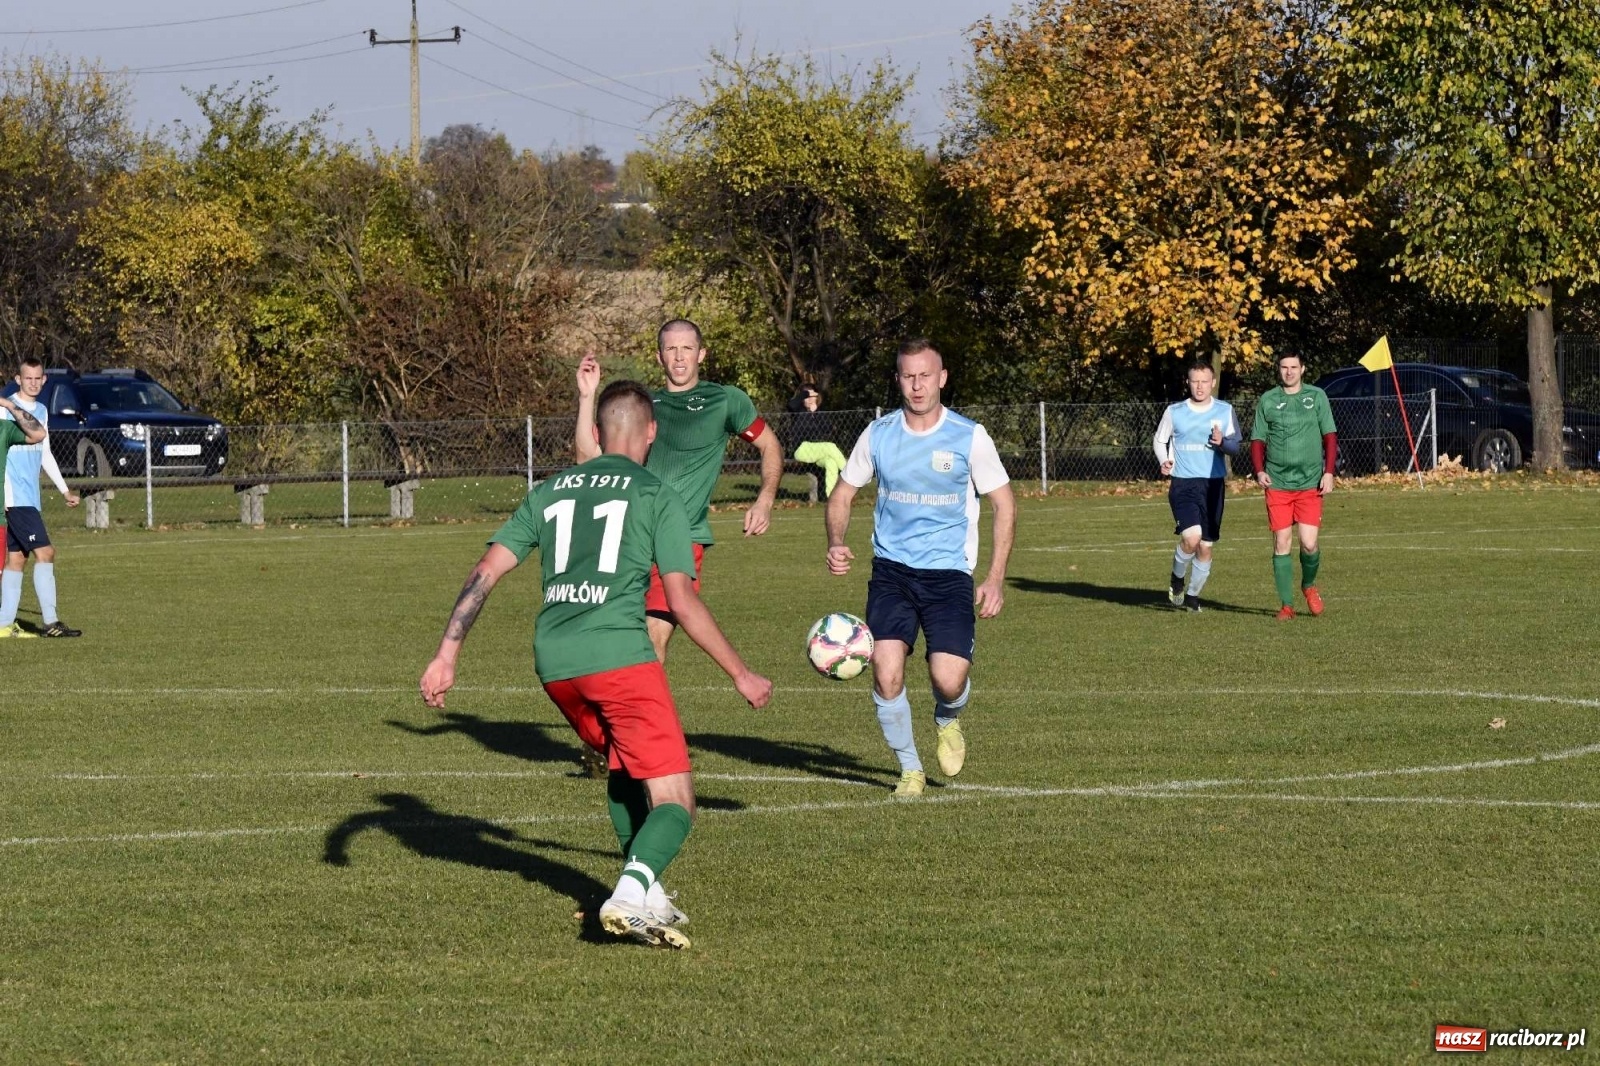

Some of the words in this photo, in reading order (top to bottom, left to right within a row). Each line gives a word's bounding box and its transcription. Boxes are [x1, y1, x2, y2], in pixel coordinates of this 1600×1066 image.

[553, 474, 586, 491] LKS
[589, 474, 632, 490] 1911
[543, 498, 629, 574] 11
